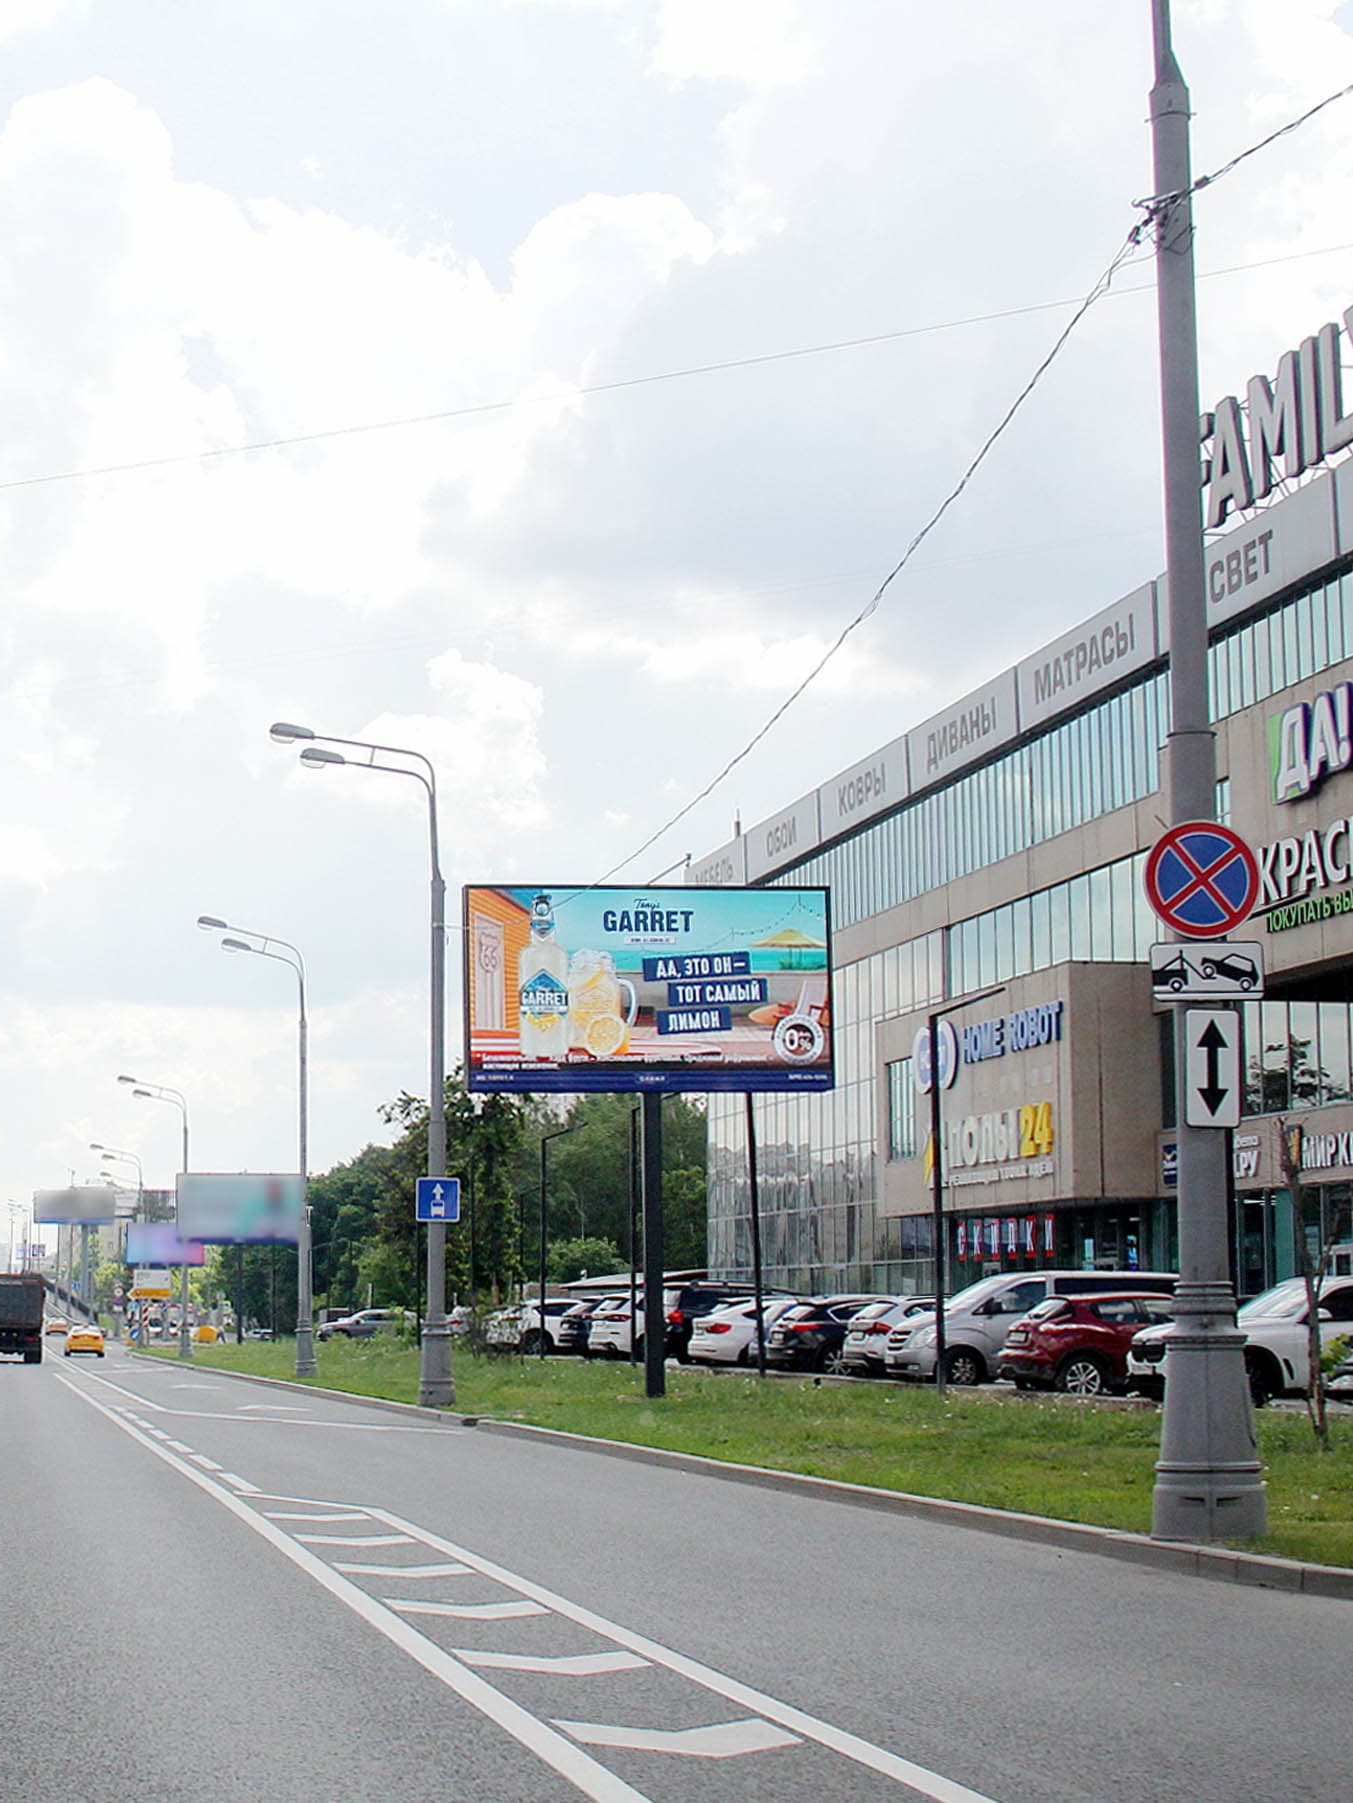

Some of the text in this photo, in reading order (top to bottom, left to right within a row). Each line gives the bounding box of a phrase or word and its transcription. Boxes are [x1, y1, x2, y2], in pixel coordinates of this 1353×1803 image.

[1200, 305, 1353, 528] AMIL
[1209, 529, 1273, 604] СВЕТ
[1034, 612, 1135, 704] МАТРАСЫ
[927, 696, 997, 774] ДИВАНЫ
[1275, 682, 1352, 801] ДА!
[838, 762, 886, 816] КОВРЫ
[766, 816, 797, 858] ОБОИ
[1259, 816, 1353, 905] КРАС
[603, 910, 694, 932] GARRET
[656, 959, 682, 978] АА,
[684, 957, 709, 976] ЭТО
[676, 980, 761, 1003] ТОТ САМЫЙ
[668, 1011, 720, 1031] ЛИМОН
[963, 1001, 1062, 1063] HOME ROBOT
[1302, 1135, 1336, 1168] МИР
